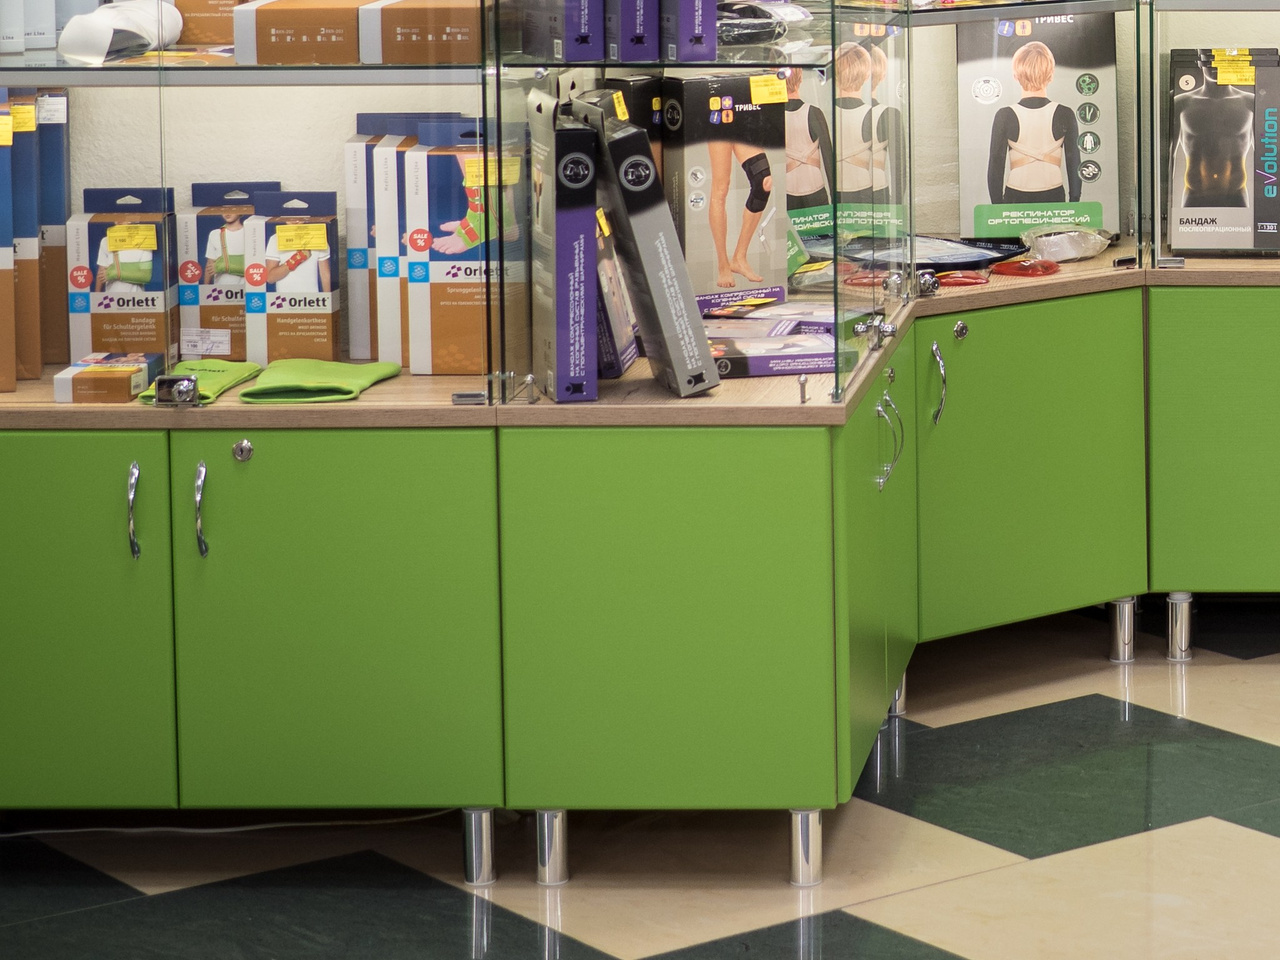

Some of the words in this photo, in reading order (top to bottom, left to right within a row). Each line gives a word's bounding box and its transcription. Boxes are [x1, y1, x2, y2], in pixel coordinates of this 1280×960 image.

[735, 103, 762, 112] ТРИВЕС
[1002, 209, 1075, 218] РЕКЛИНАТОР
[987, 214, 1091, 225] ОРТОПЕДИЧЕСКИЙ
[1179, 217, 1218, 226] БАНДАЖ
[117, 296, 157, 309] Orlett
[288, 297, 327, 308] Orlett
